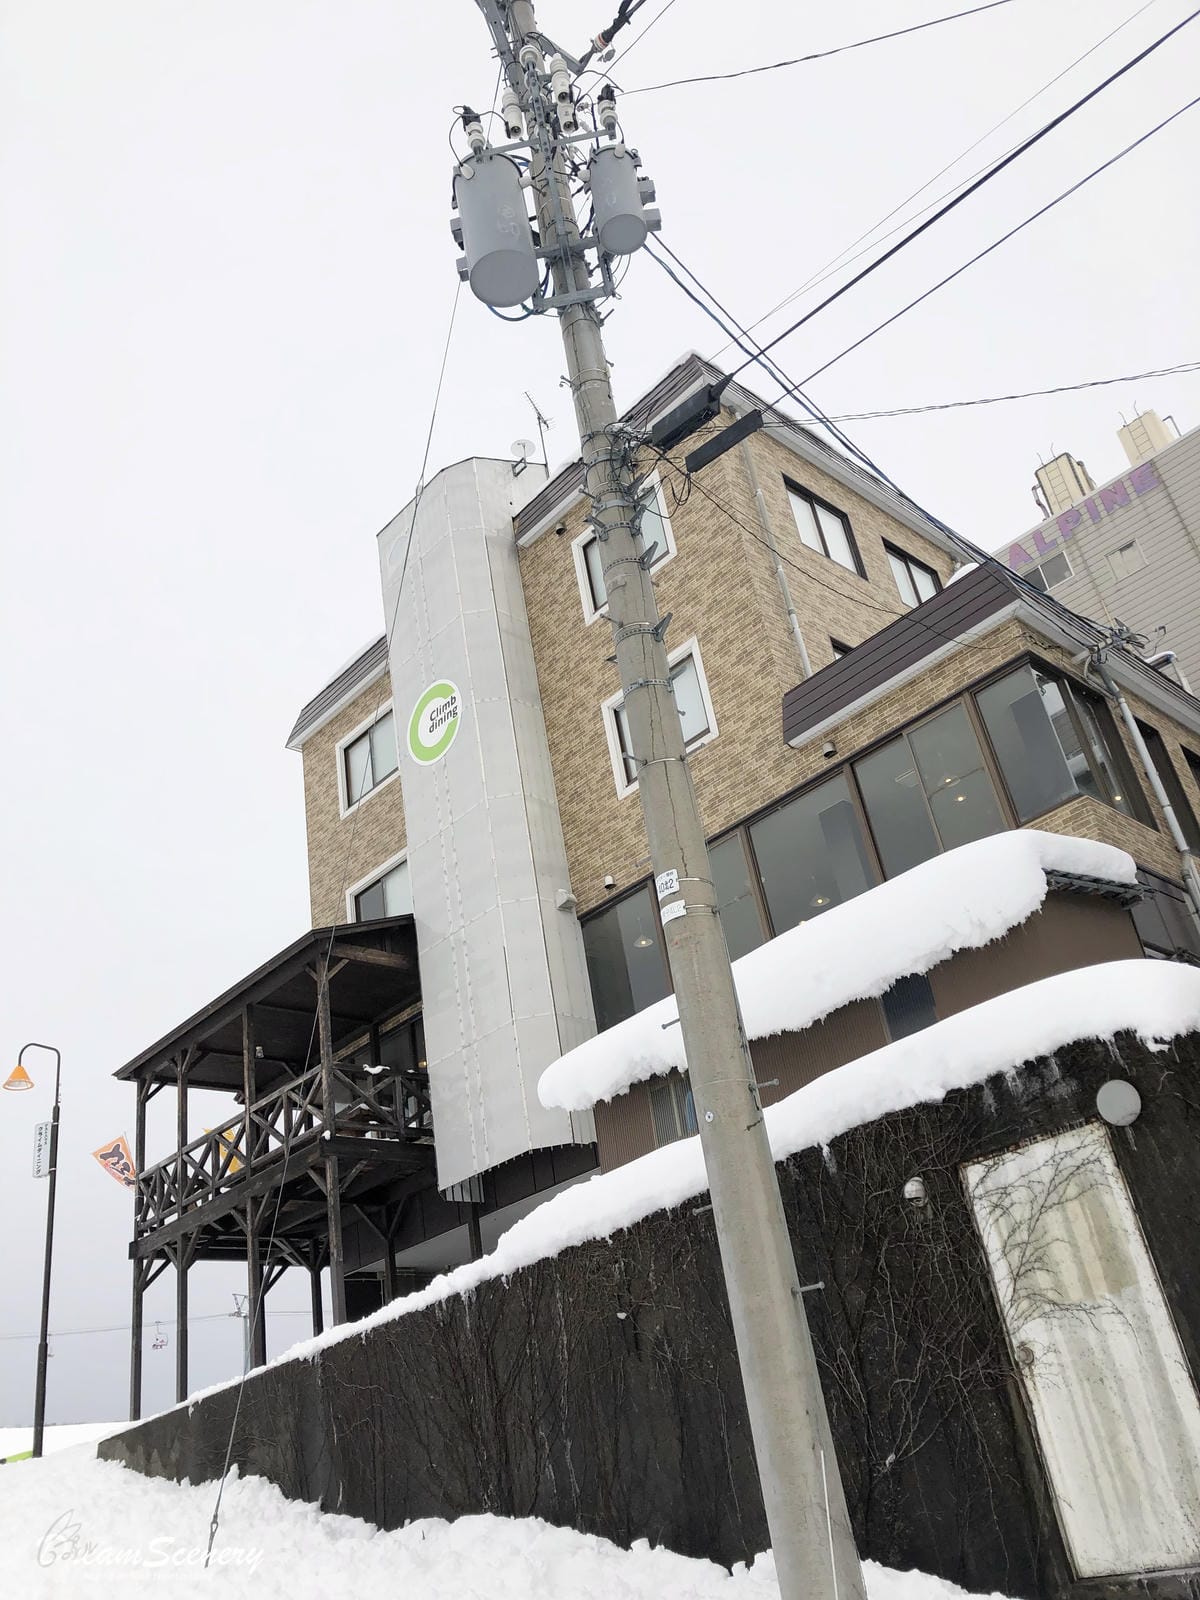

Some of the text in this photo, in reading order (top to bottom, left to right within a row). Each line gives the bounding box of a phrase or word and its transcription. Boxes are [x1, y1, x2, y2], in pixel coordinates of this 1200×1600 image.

[1009, 462, 1161, 570] ALPINE
[429, 695, 457, 722] Climb
[429, 705, 459, 734] dining
